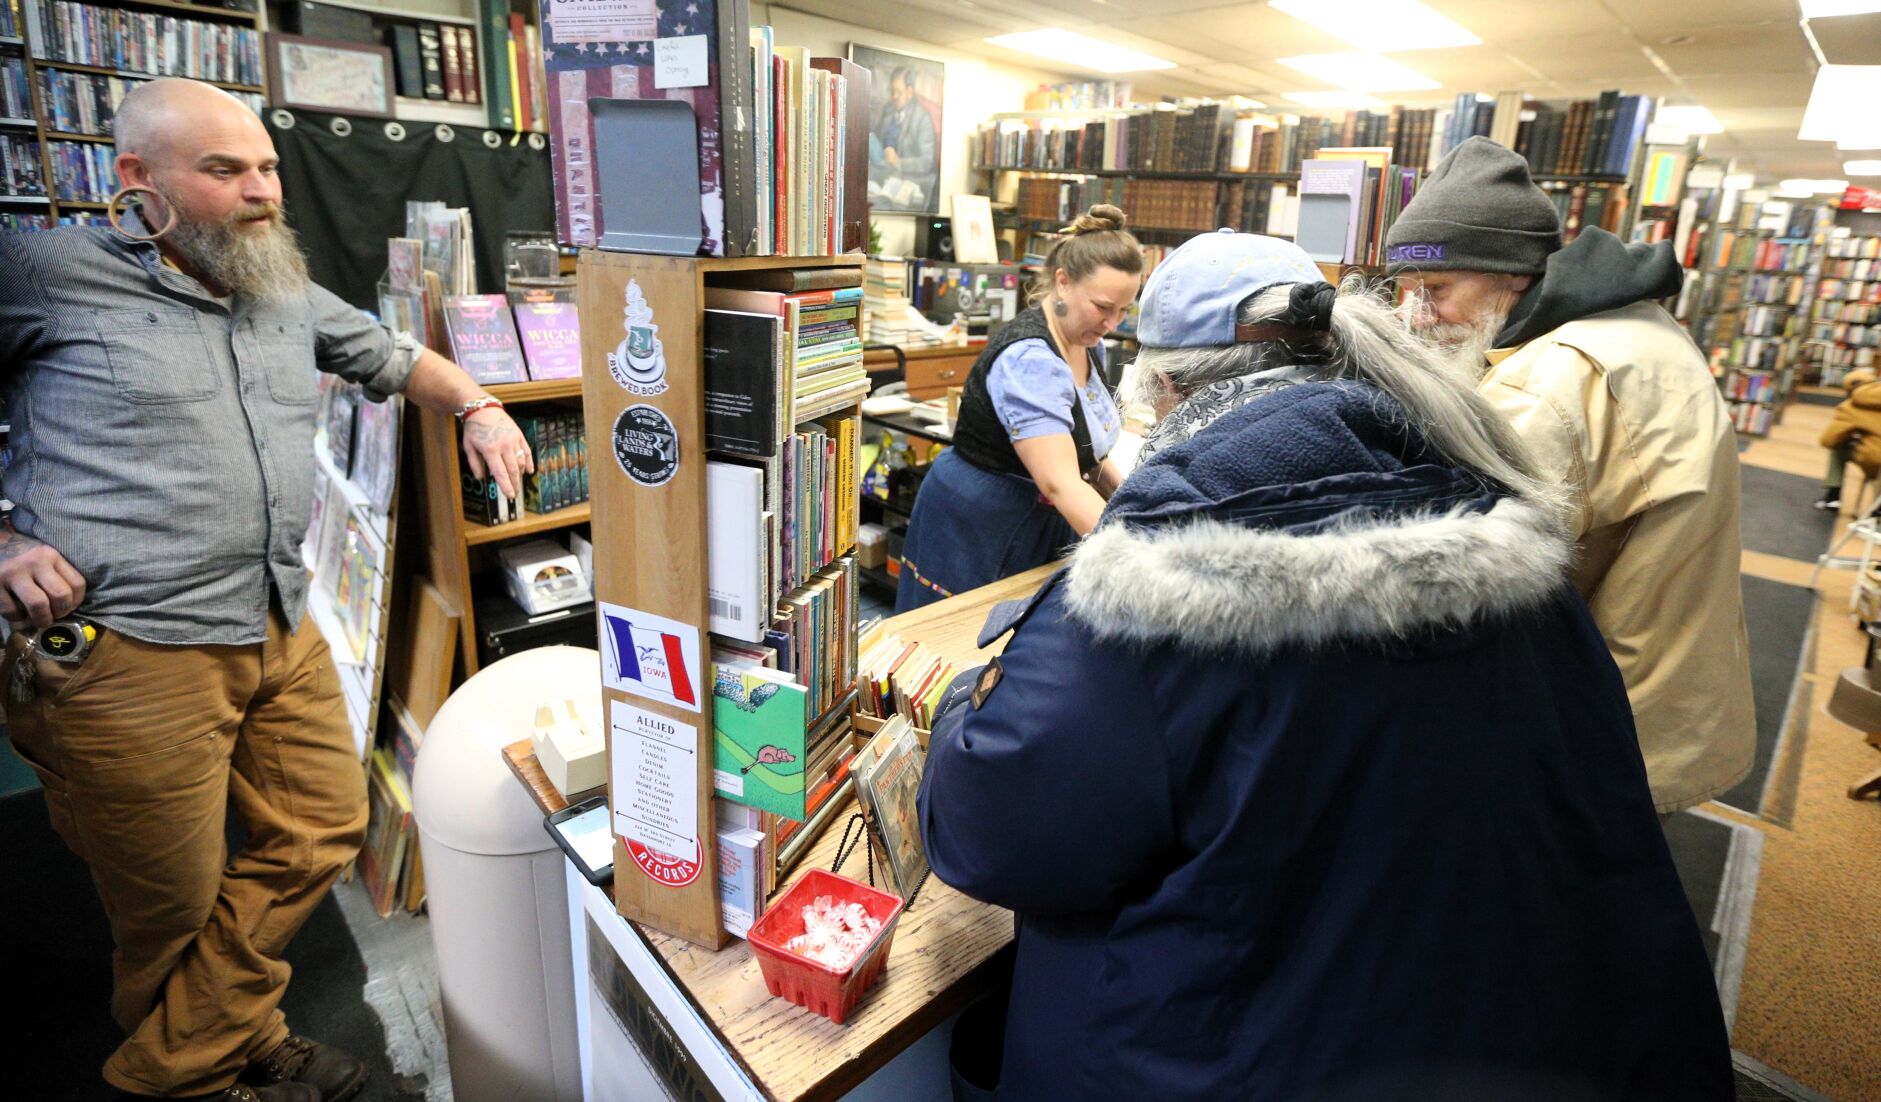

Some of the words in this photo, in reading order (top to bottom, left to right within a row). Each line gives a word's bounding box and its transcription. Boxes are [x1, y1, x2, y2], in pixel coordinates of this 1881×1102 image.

[456, 333, 513, 346] WICCA
[527, 329, 578, 342] WICCA
[609, 359, 639, 393] BREWED
[641, 381, 667, 395] BOOK
[617, 435, 646, 448] LANDS
[624, 428, 654, 441] LIVING
[622, 443, 654, 457] WATERS
[632, 466, 649, 479] YEARS
[643, 666, 667, 680] IOWA
[636, 715, 675, 735] ALLIED
[641, 740, 667, 754] FLANNEL
[641, 749, 667, 762] CANDLES
[645, 758, 664, 769] DENIM
[638, 764, 671, 780] COCKTAILS
[639, 772, 652, 782] SELF
[654, 778, 670, 788] CARE
[635, 779, 652, 790] HOME
[654, 786, 674, 798] GOODS
[637, 788, 672, 805] STATIONERY
[637, 797, 650, 805] AND
[651, 802, 670, 812] OTHER
[632, 802, 679, 824] MISCELLANEOUS
[641, 813, 670, 829] SUNDRIES
[638, 851, 694, 881] RECORDS
